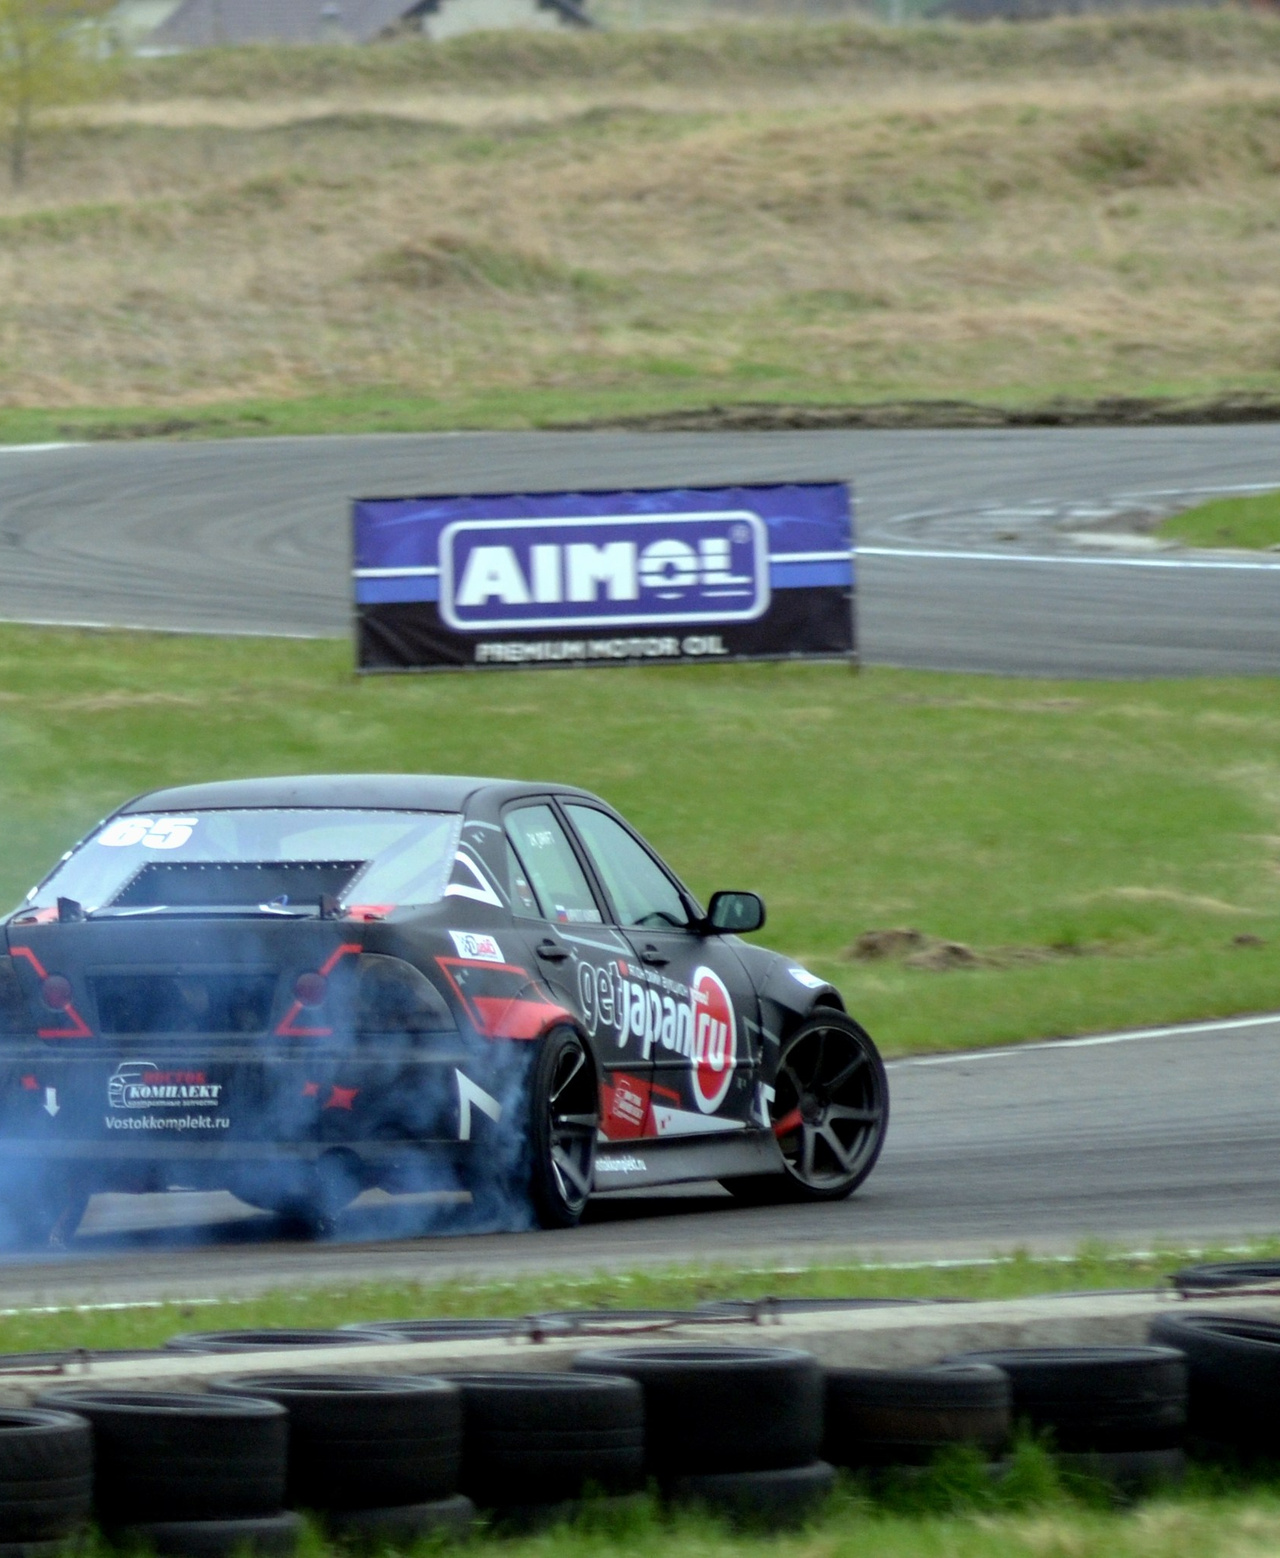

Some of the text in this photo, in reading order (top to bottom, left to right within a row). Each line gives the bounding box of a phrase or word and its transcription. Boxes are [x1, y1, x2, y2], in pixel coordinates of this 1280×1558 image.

[456, 538, 753, 606] AIMOL
[475, 635, 729, 663] PREMIUM MOTOR OIL
[97, 817, 199, 849] 65
[130, 1085, 222, 1098] КОМПЛЕКТ
[105, 1115, 230, 1131] Vostokkomplekt.ru
